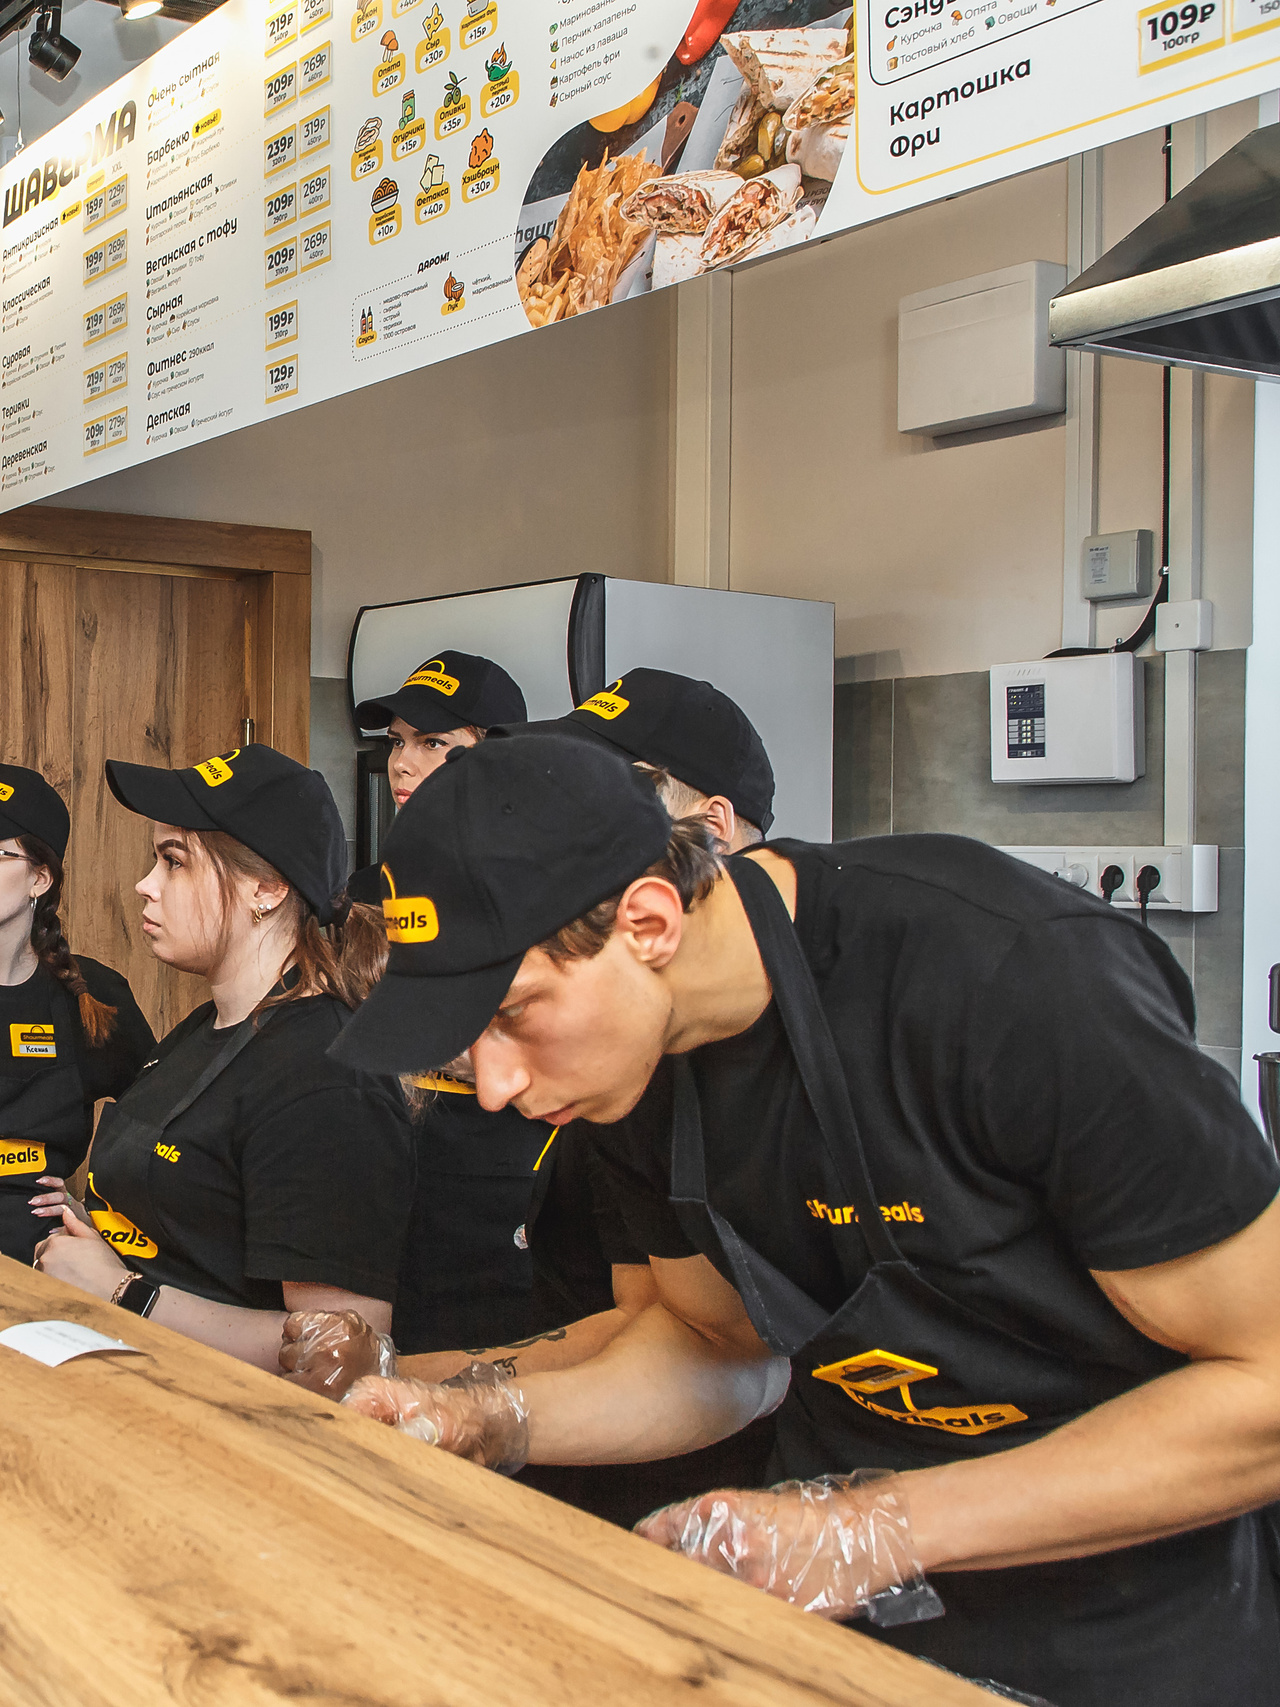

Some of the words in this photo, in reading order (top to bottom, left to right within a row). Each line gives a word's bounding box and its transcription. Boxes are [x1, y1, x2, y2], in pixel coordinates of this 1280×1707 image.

[356, 7, 378, 24] Бекон
[561, 26, 592, 48] Перчик
[593, 3, 637, 31] халапеньо
[900, 22, 942, 45] Курочка
[964, 1, 998, 20] Опята
[425, 38, 440, 51] Сыр
[560, 47, 584, 67] Начос
[585, 42, 596, 56] из
[597, 27, 629, 48] лаваша
[900, 38, 948, 64] Тостовый
[950, 26, 975, 45] хлеб
[998, 3, 1038, 25] Овощи
[1162, 32, 1200, 51] 100гр
[147, 83, 177, 108] Очень
[179, 51, 220, 87] сытная
[378, 60, 401, 78] Опята
[559, 57, 602, 85] Картофель
[603, 49, 621, 64] фри
[559, 80, 592, 102] Сырный
[594, 72, 612, 86] соус
[890, 58, 1032, 127] Картошка
[439, 101, 466, 121] Оливки
[147, 131, 190, 165] Барбекю
[392, 122, 425, 144] Огурчики
[889, 127, 941, 158] Фри
[462, 162, 501, 186] Хэшбраун
[145, 173, 213, 220] Итальянская
[416, 187, 449, 207] Фетакса
[2, 217, 59, 262] Антикризисная
[145, 239, 196, 275] Веганская
[198, 235, 205, 248] с
[206, 218, 238, 244] тофу
[417, 251, 450, 274] ДАРОМ!
[2, 276, 51, 313] Классическая
[146, 294, 183, 320] Сырная
[2, 345, 31, 370] Суровая
[147, 350, 187, 376] Фитнес
[1, 398, 30, 419] Терияки
[146, 402, 192, 432] Детская
[1, 440, 48, 470] Деревенская
